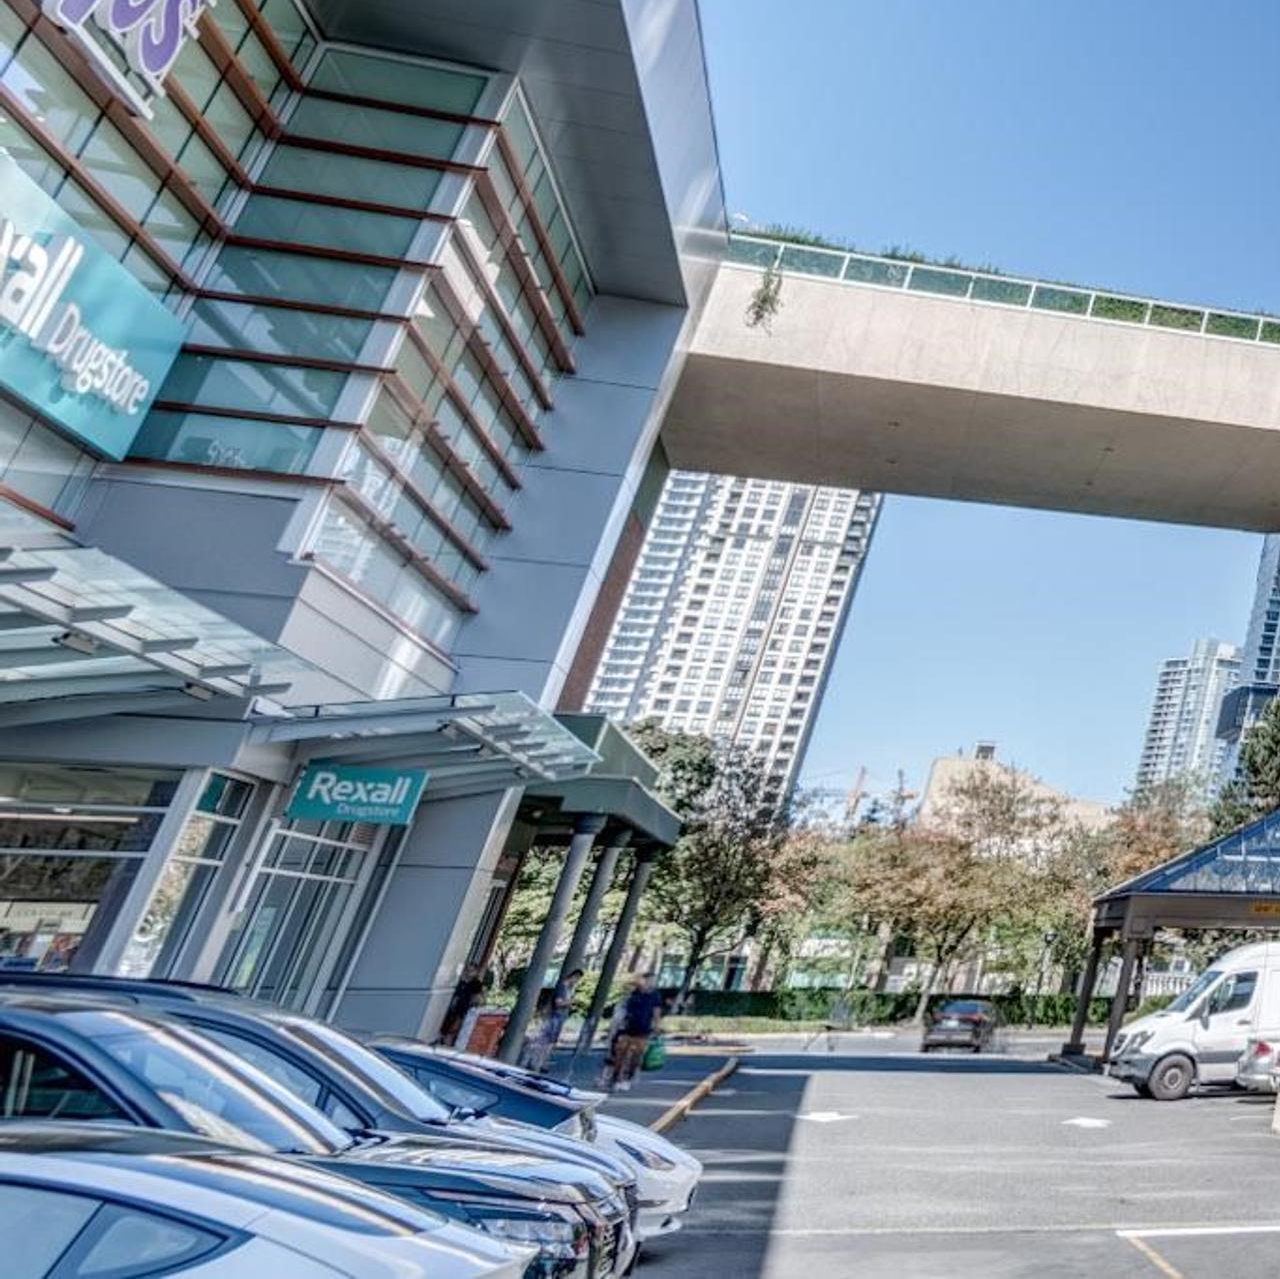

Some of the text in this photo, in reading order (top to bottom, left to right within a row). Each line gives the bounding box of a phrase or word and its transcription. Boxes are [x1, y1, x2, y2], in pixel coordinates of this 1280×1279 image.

[47, 301, 150, 416] Drugstore
[307, 772, 412, 804] Rexall
[337, 803, 400, 817] Drugstore
